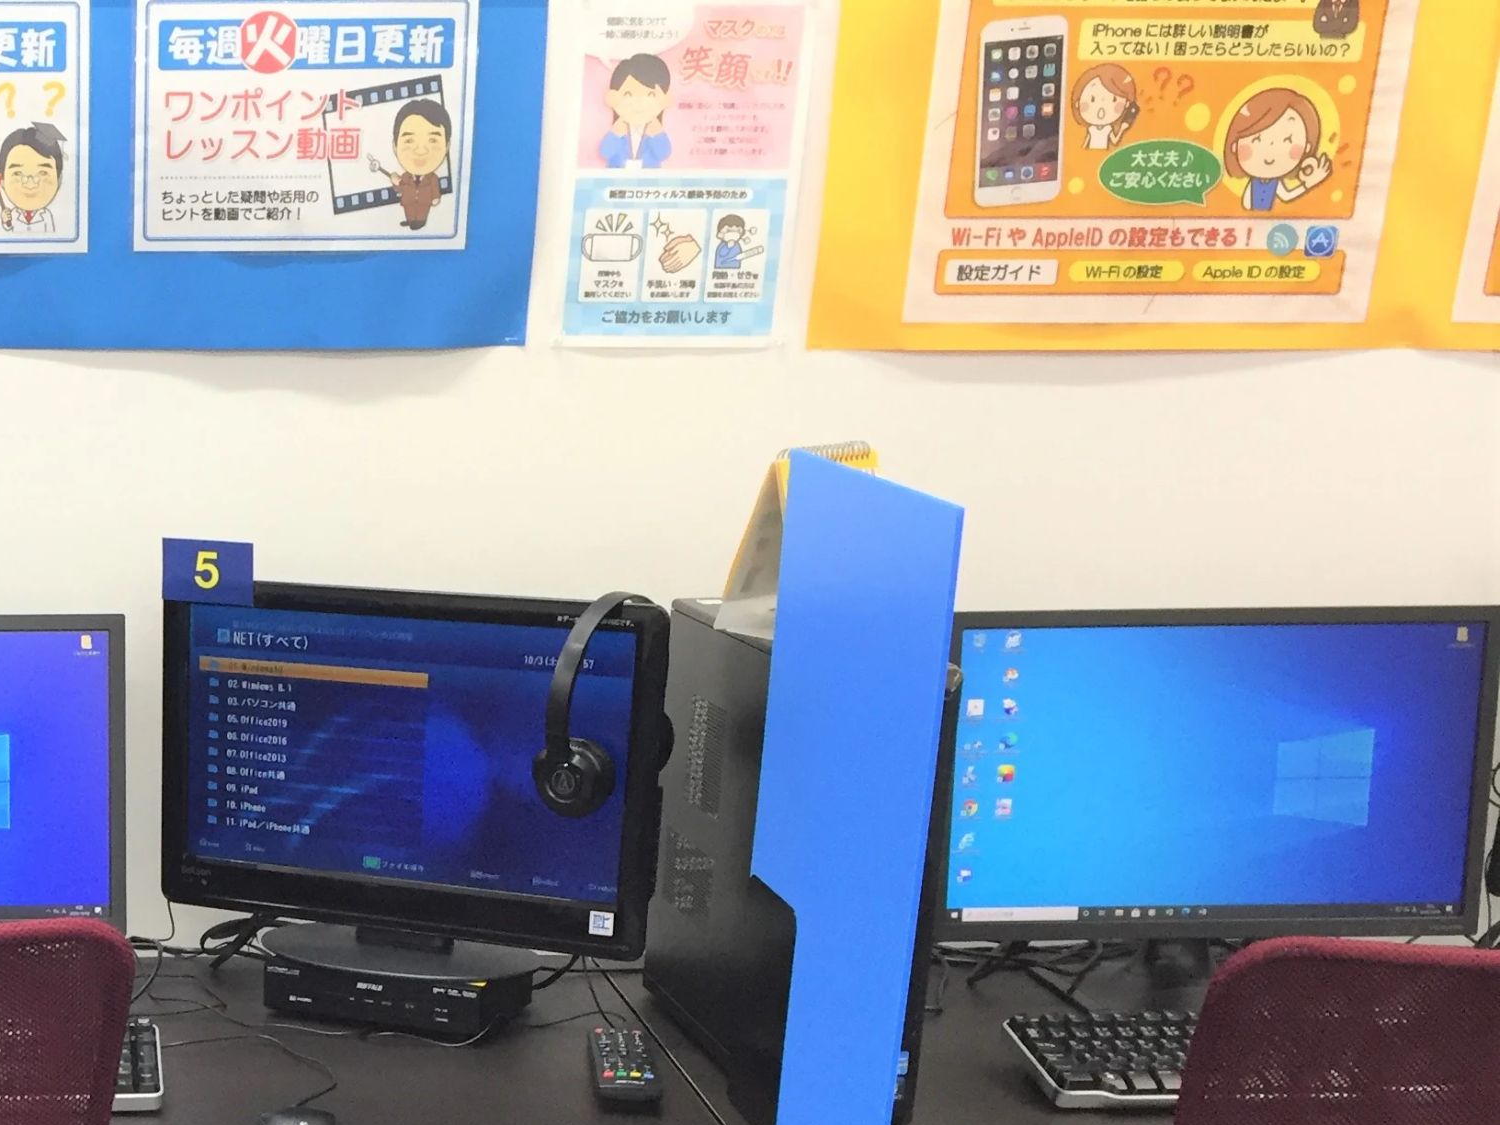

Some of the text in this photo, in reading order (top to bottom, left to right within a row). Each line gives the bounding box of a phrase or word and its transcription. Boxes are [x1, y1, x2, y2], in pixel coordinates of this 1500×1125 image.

[168, 14, 444, 66] 毎週火曜日更新
[165, 87, 361, 122] ワンポイント
[166, 128, 361, 161] レッスン動画
[1109, 171, 1210, 189] ご安心ください
[161, 190, 319, 204] ちょっとした疑問や活用の
[161, 208, 301, 221] ヒントを動画でご紹介！
[956, 264, 1041, 282] 設定ガイド
[601, 310, 732, 324] ご協力をお願いします
[193, 551, 220, 590] 5
